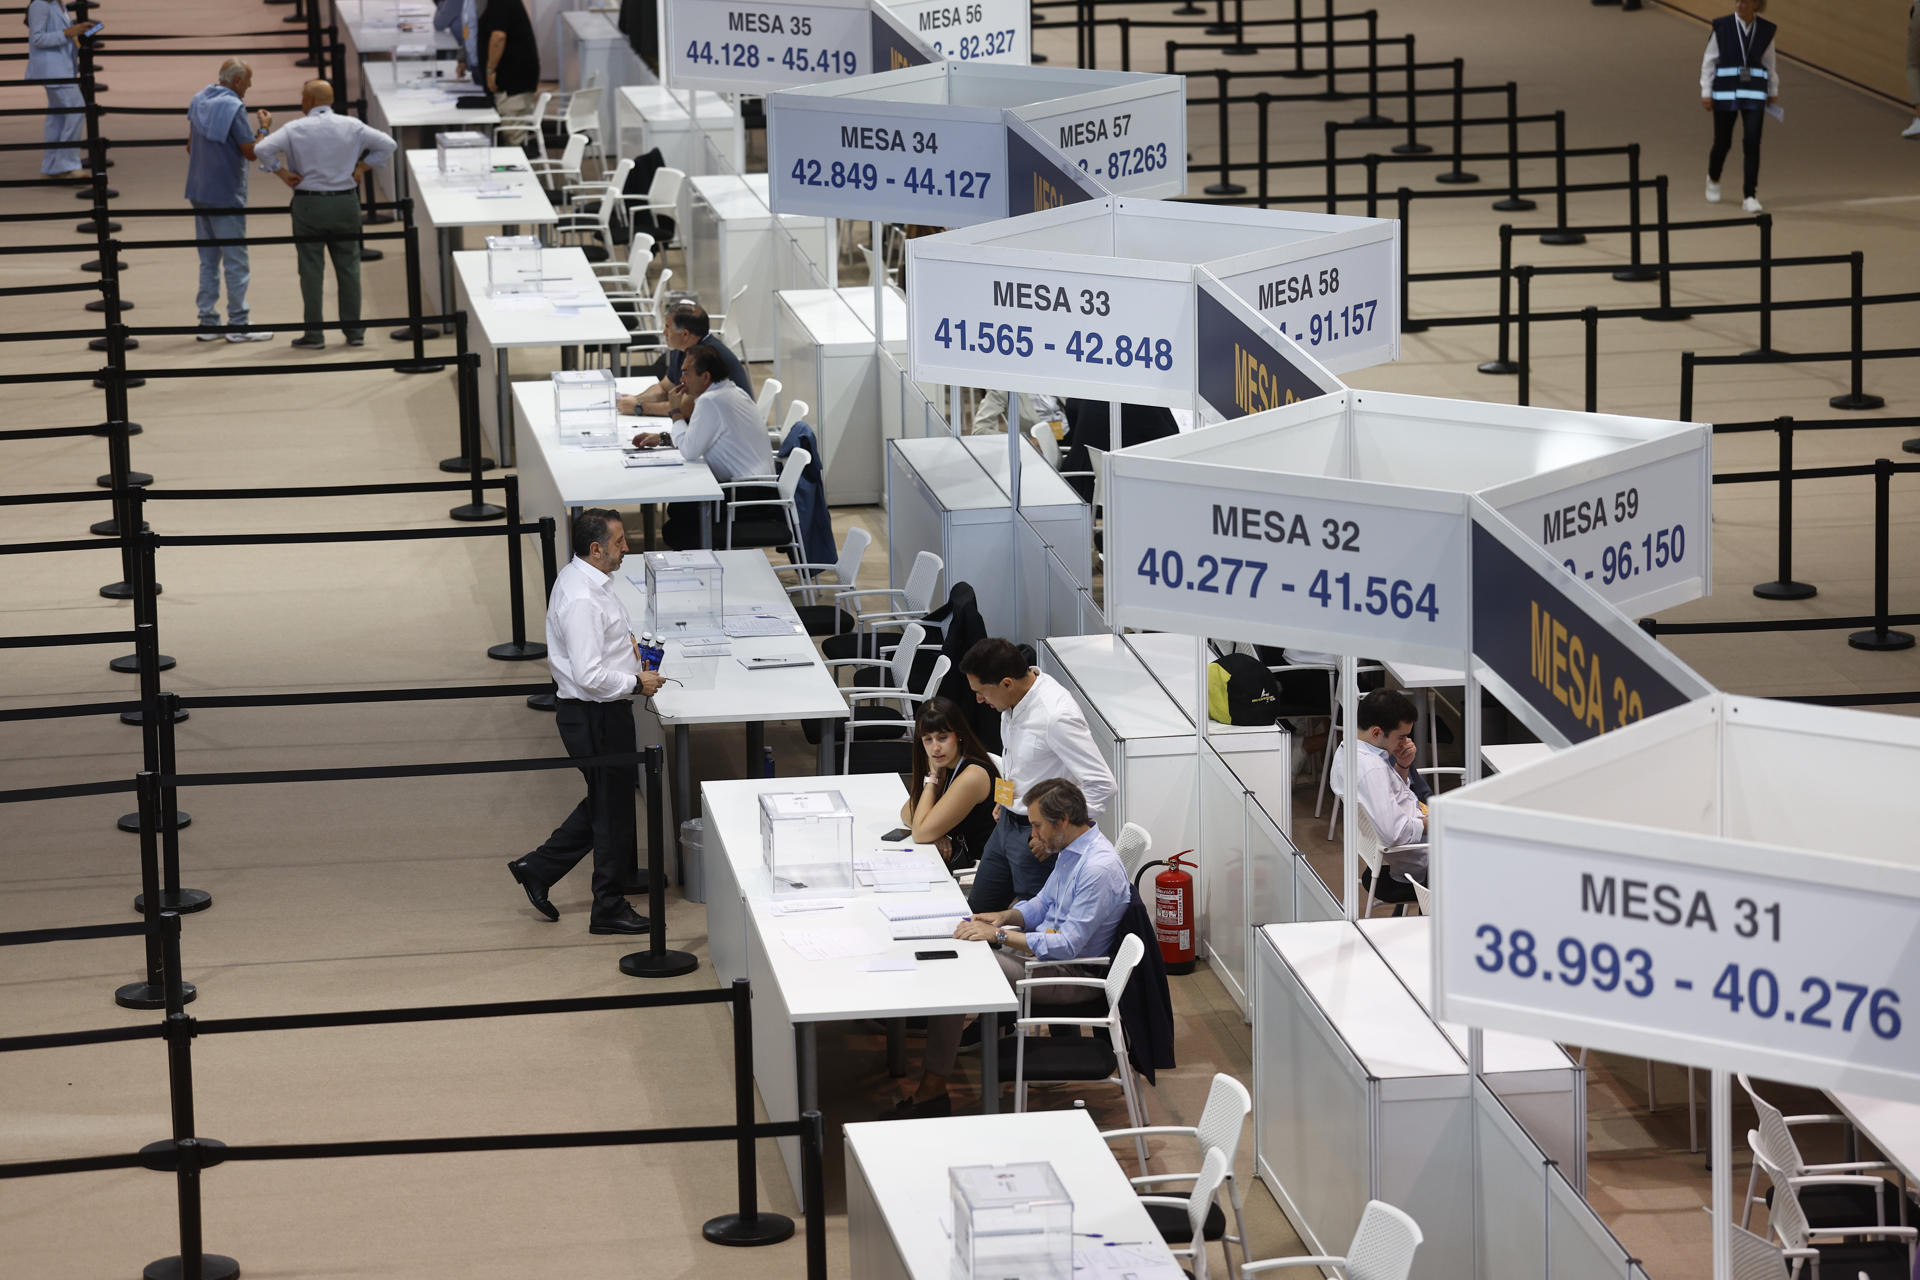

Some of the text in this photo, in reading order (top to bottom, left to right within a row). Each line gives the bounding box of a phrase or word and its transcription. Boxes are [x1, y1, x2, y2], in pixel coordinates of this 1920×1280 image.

[729, 12, 811, 36] MESA 35
[920, 4, 981, 30] MESA 56
[687, 41, 759, 68] 44.128
[783, 48, 856, 75] 45.419
[960, 29, 1015, 60] 82.327
[841, 126, 938, 154] MESA 34
[1060, 114, 1131, 149] MESA 57
[792, 158, 991, 199] 42.849 - 44.127
[1108, 143, 1166, 179] 87.263
[994, 281, 1110, 316] MESA 33
[1259, 268, 1339, 310] MESA 58
[1295, 333, 1303, 341] -
[1310, 300, 1377, 345] 91.157
[935, 318, 1172, 371] 41.565 - 42.848
[1235, 344, 1279, 415] MESA
[1213, 504, 1360, 552] MESA 32
[1544, 488, 1638, 545] MESA 59
[1584, 570, 1594, 580] -
[1603, 525, 1685, 584] 96.150
[1138, 548, 1439, 622] 40.277 - 41.564
[1531, 599, 1605, 736] MESA
[1582, 874, 1780, 942] MESA 31
[1476, 924, 1902, 1040] 38.993 - 40.276
